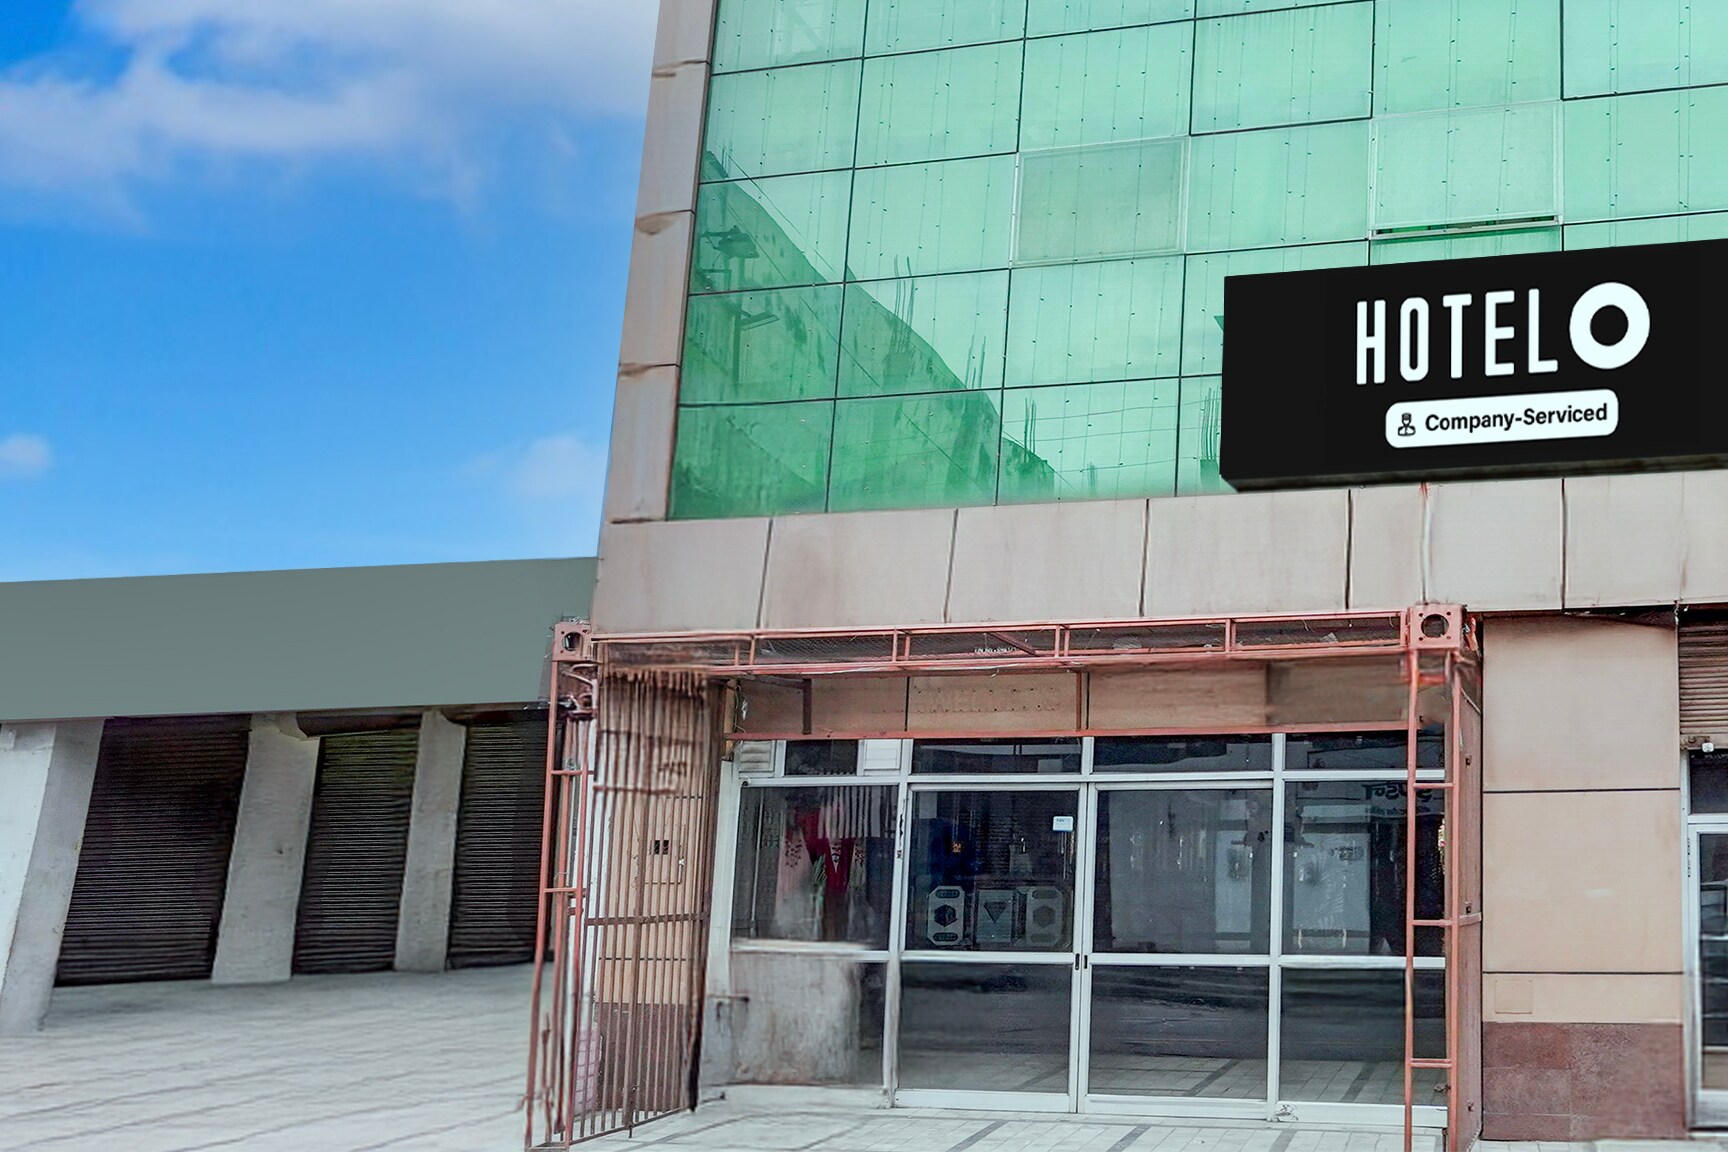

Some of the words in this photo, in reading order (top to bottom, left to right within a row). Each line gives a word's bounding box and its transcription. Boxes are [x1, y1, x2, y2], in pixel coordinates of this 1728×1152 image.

[1356, 288, 1559, 385] HOTEL
[1569, 281, 1651, 370] O
[1424, 402, 1608, 434] Company-Serviced
